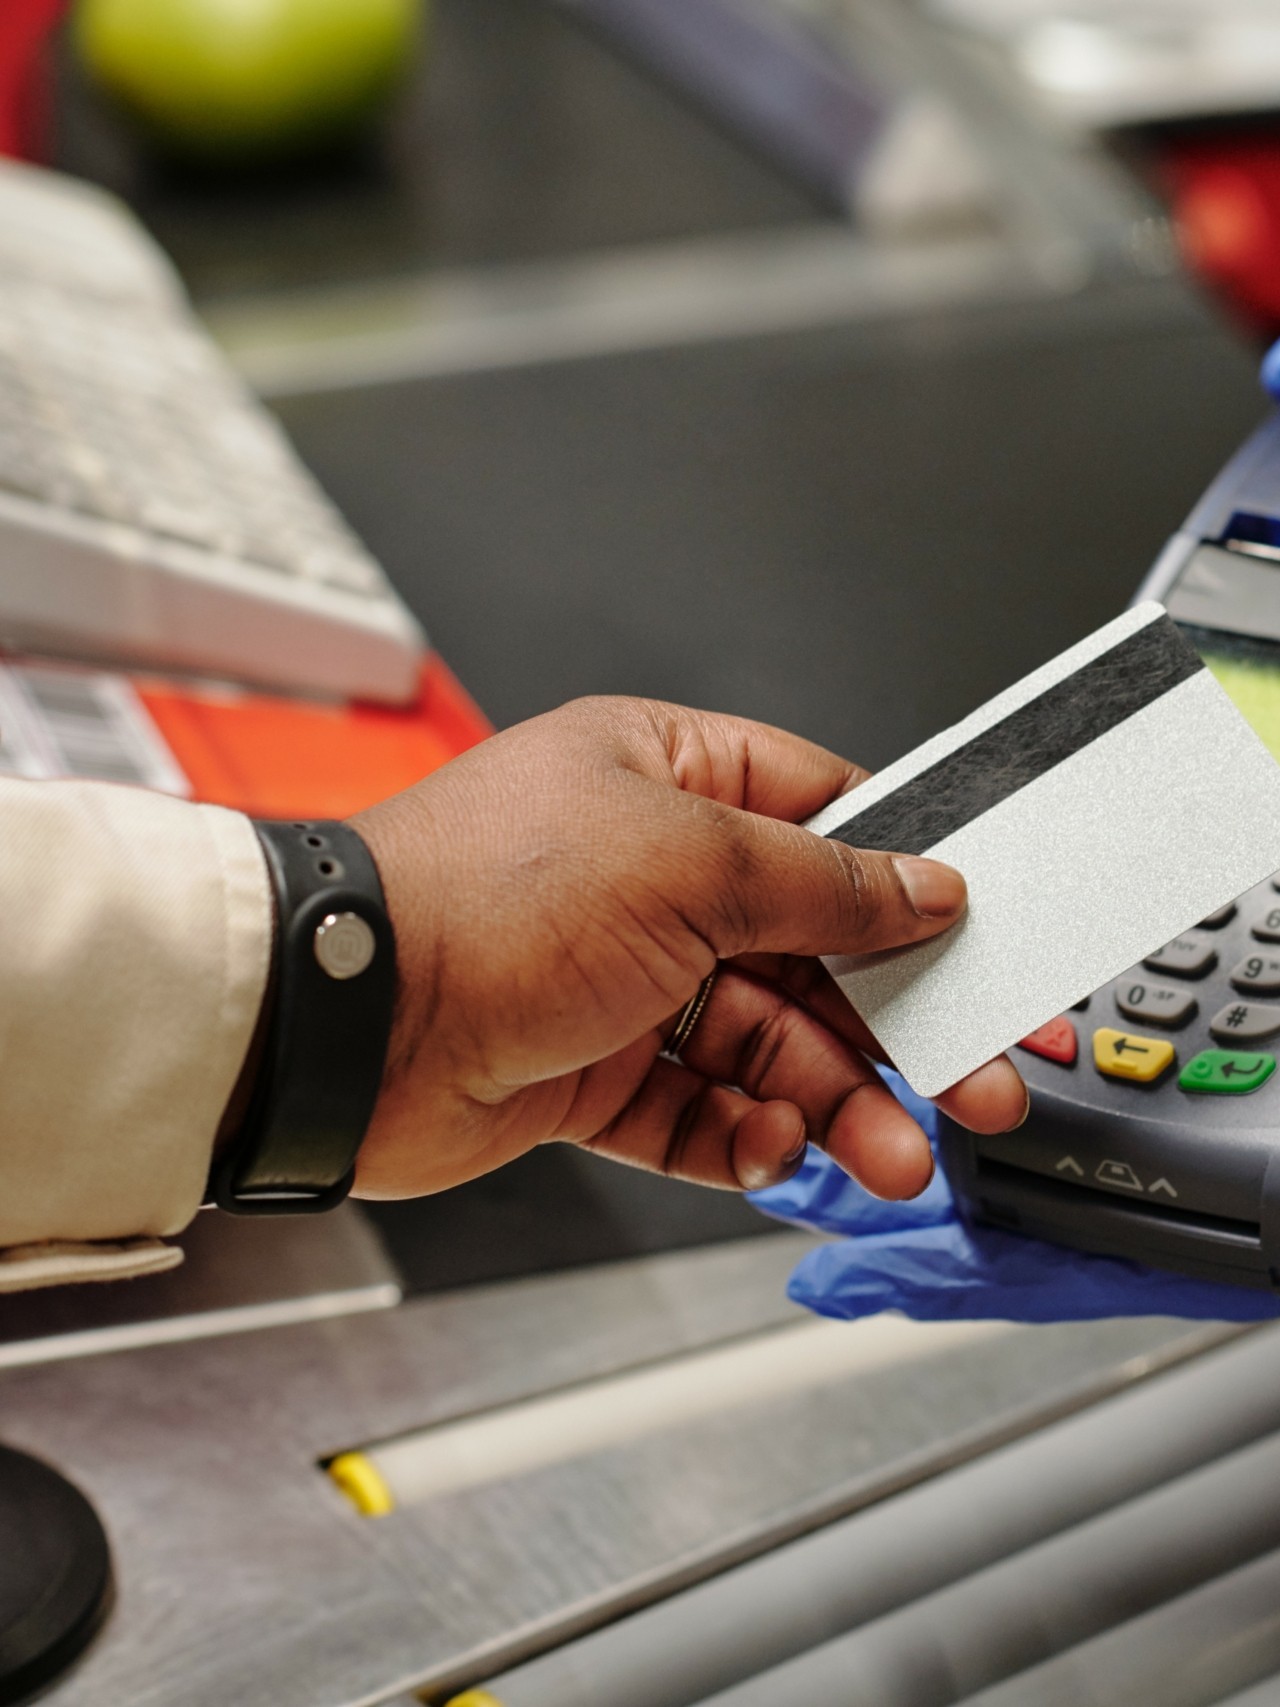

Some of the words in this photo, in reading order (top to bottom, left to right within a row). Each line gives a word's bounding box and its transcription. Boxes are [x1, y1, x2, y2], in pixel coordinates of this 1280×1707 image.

[1244, 957, 1263, 979] 9
[1127, 984, 1146, 1006] 0
[1226, 1005, 1249, 1029] #
